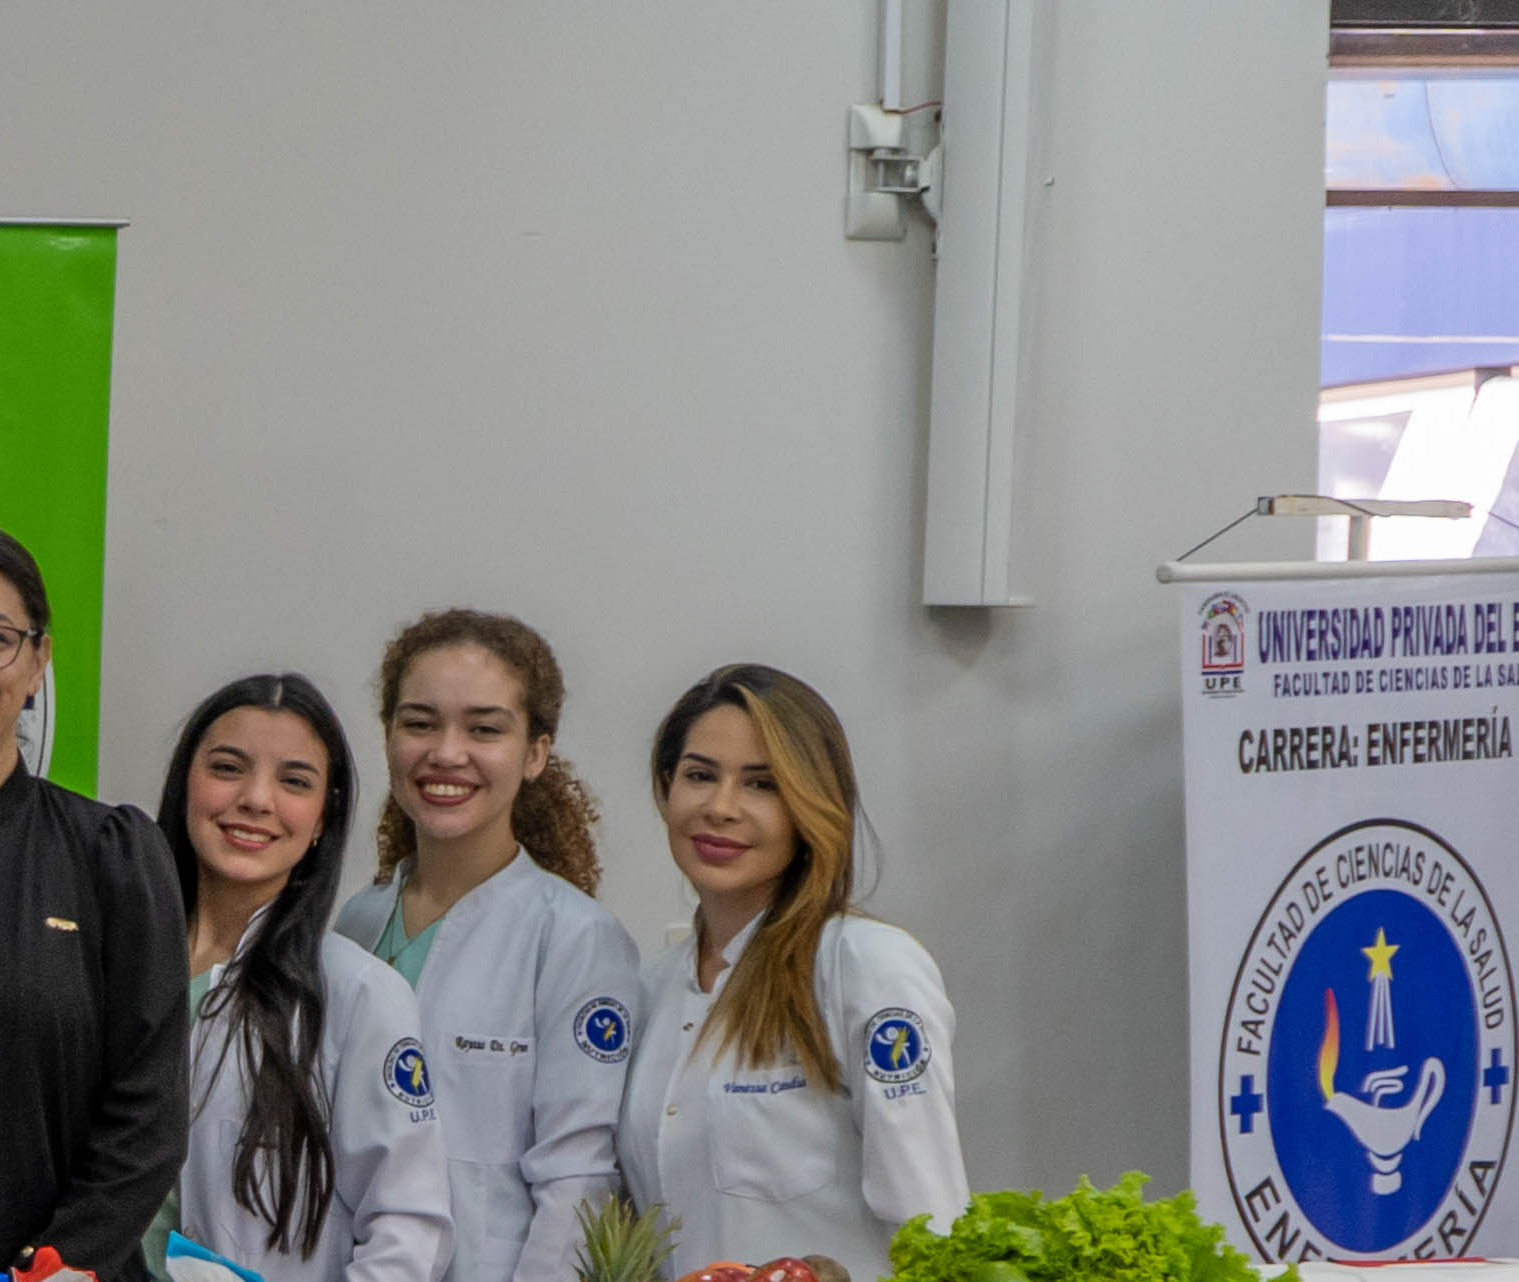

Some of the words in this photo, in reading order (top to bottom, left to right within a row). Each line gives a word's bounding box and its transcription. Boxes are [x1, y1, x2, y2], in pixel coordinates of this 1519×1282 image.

[1258, 607, 1385, 664] UNIVERSIDAD
[1391, 604, 1468, 658] PRIVADA
[1474, 603, 1507, 654] DEL
[1205, 676, 1241, 689] UPE
[1273, 670, 1350, 698] FACULTAD
[1355, 669, 1373, 694] DE
[1379, 666, 1448, 693] CIENCIAS
[1453, 665, 1471, 689] DE
[1476, 664, 1493, 688] LA
[1238, 725, 1359, 774] CARRERA:
[1367, 706, 1513, 766] ENFERMERÍA
[1236, 901, 1305, 1056] FACULTAD
[1302, 866, 1334, 914] DE
[1336, 842, 1426, 889] CIENCIAS
[1427, 861, 1455, 907] DE
[1451, 889, 1477, 938] LA
[1469, 927, 1504, 1030] SALUD
